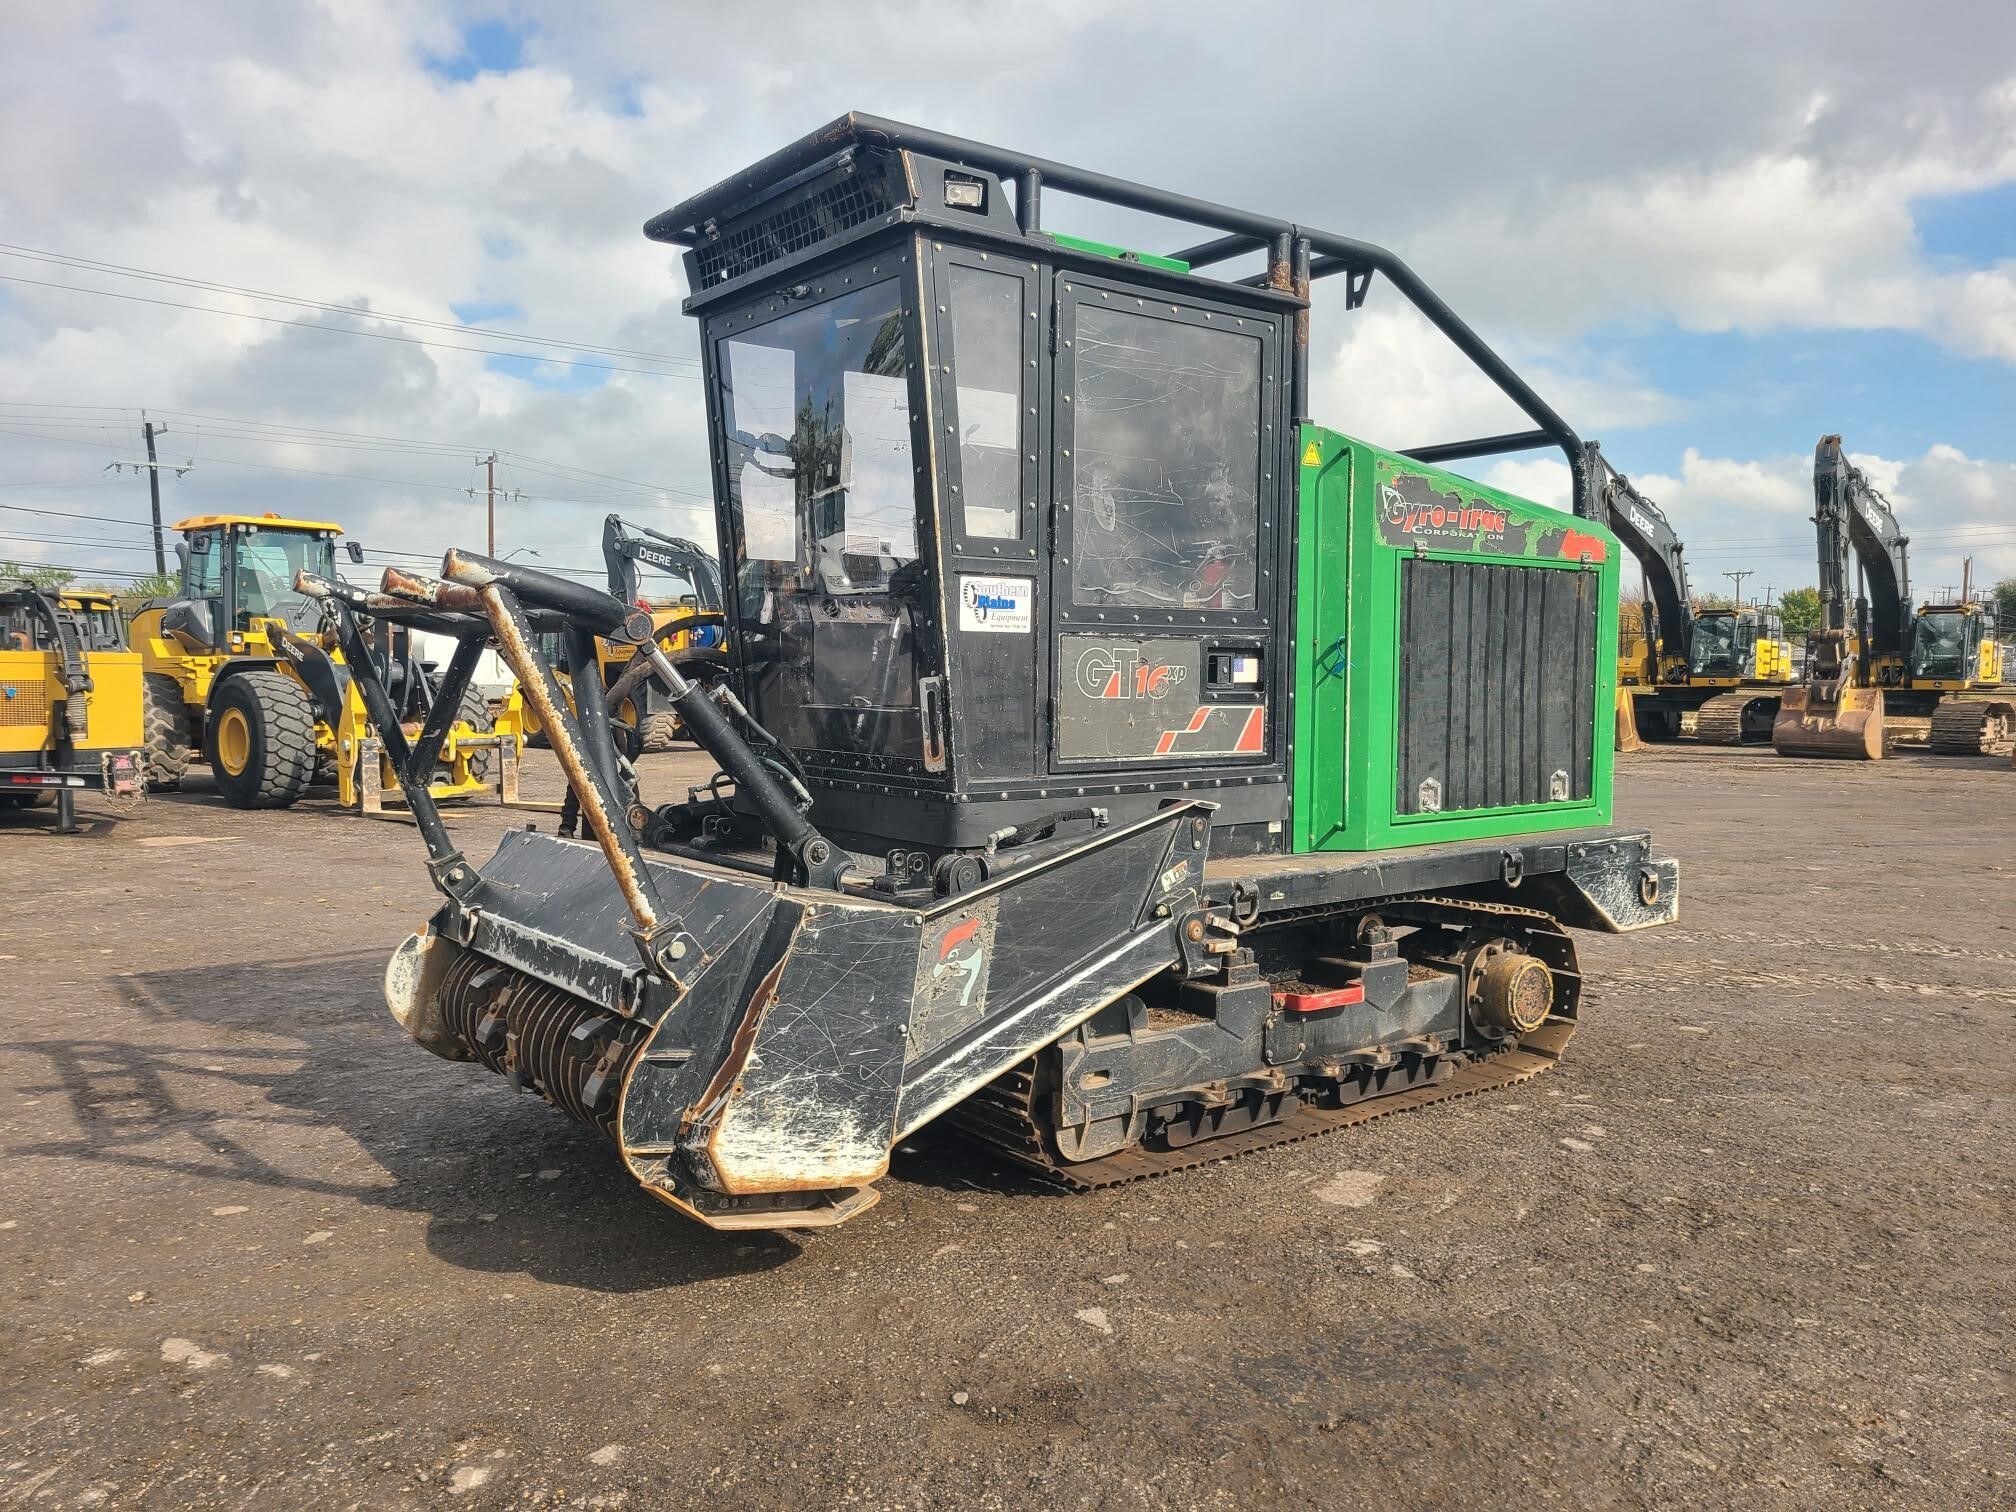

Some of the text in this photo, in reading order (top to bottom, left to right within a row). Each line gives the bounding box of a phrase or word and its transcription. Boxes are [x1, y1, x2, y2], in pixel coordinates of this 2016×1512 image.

[1629, 505, 1655, 538] DEERE
[1412, 525, 1504, 541] CORPORATON
[639, 546, 672, 566] DEERE
[974, 580, 1028, 598] Southern
[977, 594, 1016, 610] Plains
[991, 612, 1029, 623] Equipment
[281, 636, 305, 662] DEERE
